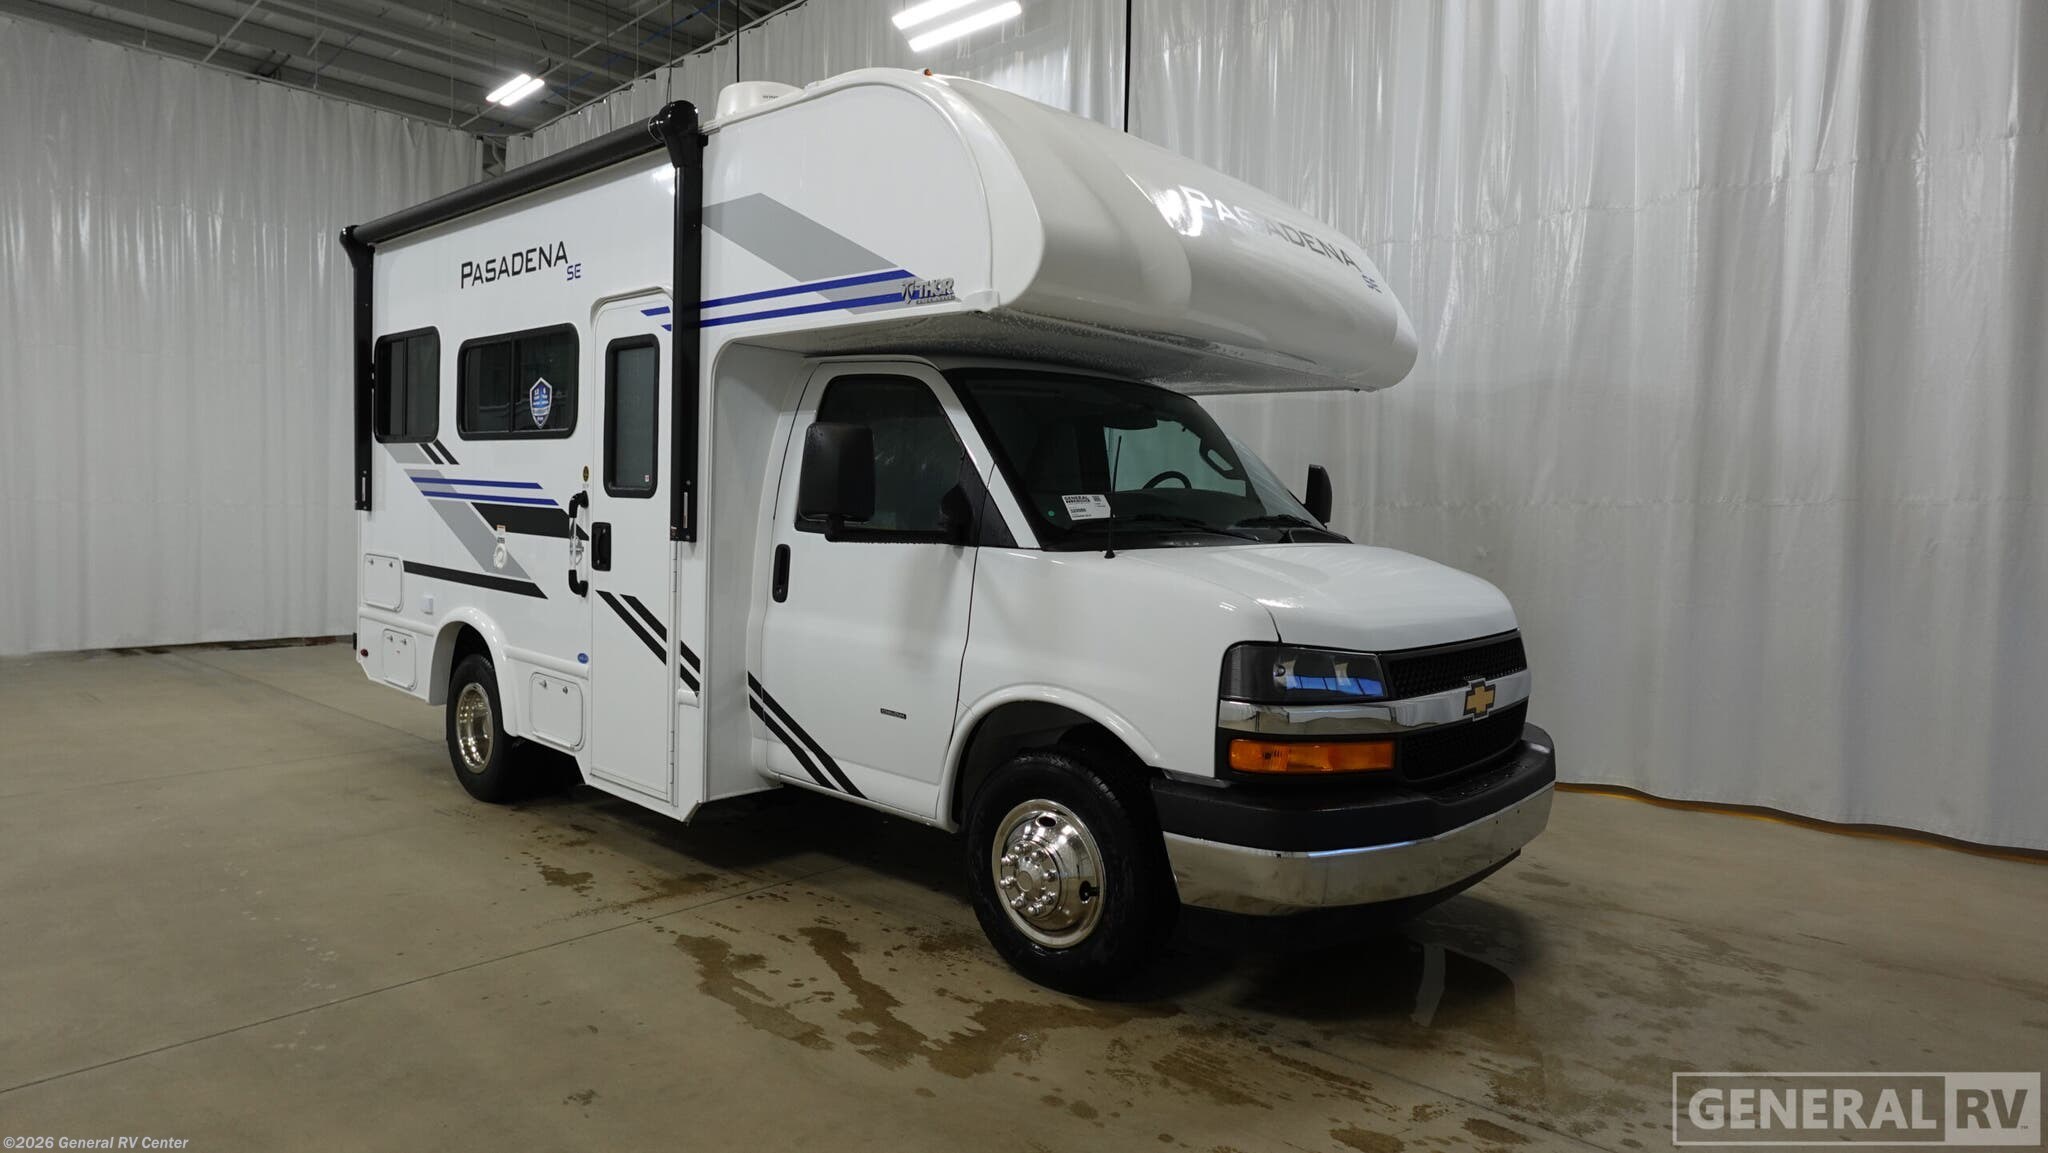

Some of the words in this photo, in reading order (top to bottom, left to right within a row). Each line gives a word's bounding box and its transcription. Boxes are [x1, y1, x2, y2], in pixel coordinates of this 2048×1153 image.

[1178, 185, 1363, 272] PASADENA
[460, 241, 568, 289] PASADENA
[566, 263, 582, 281] SE
[916, 277, 955, 300] THOR
